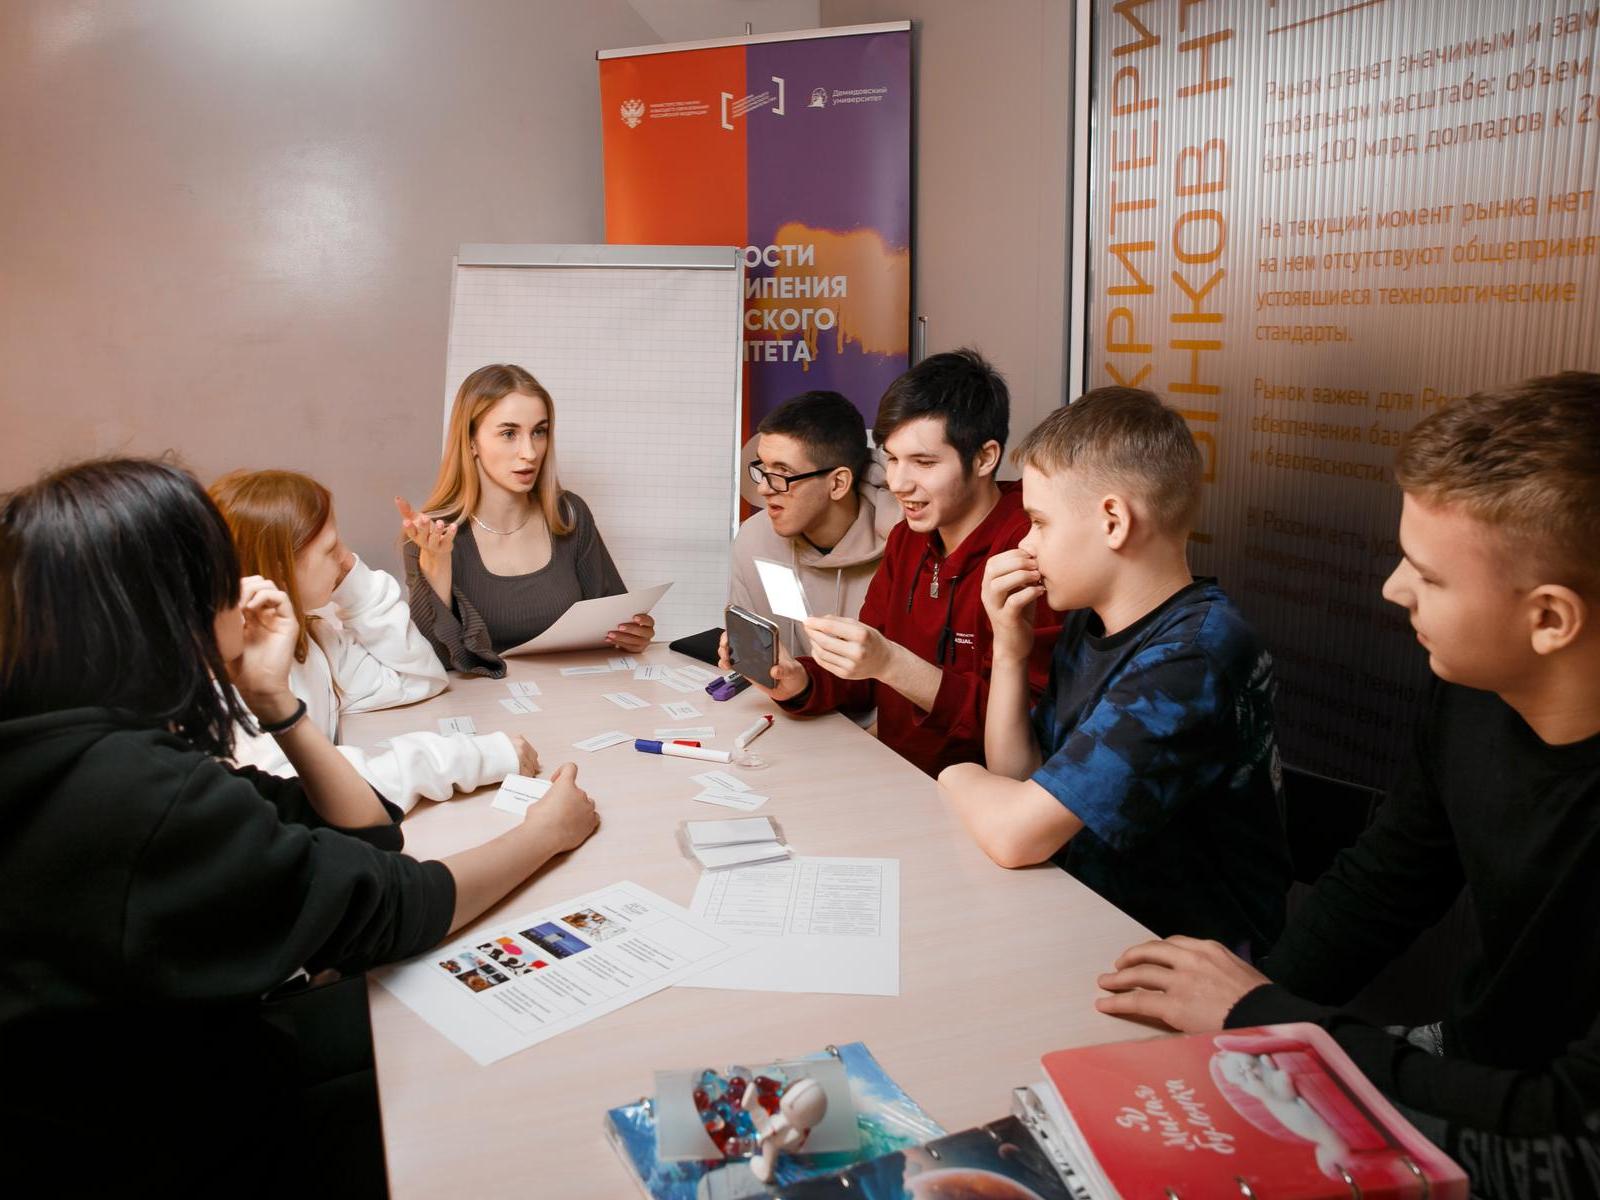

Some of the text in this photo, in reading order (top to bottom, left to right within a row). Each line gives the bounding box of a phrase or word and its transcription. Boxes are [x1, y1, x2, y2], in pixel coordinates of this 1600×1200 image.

[1266, 77, 1322, 103] Рынок
[1328, 59, 1392, 90] станет
[1398, 29, 1515, 74] значимым
[1527, 22, 1542, 44] и
[1264, 56, 1590, 138] глобальном масштабе: объем
[1264, 151, 1314, 173] более
[1321, 137, 1357, 165] 100
[1365, 134, 1418, 160] млрд
[1424, 112, 1543, 153] долларов
[1553, 107, 1569, 128] к
[1260, 190, 1594, 240] На текущий момент рынка нет
[1259, 256, 1278, 272] на
[1282, 255, 1316, 272] нем
[1324, 247, 1445, 273] отсутствуют
[1256, 282, 1577, 311] устоявшиеся технологические
[744, 308, 835, 331] СКОГО
[1256, 324, 1354, 346] стандарты.
[1254, 378, 1304, 402] Рынок
[1312, 387, 1369, 406] важен
[1376, 392, 1414, 412] для
[1252, 411, 1361, 442] обеспечения
